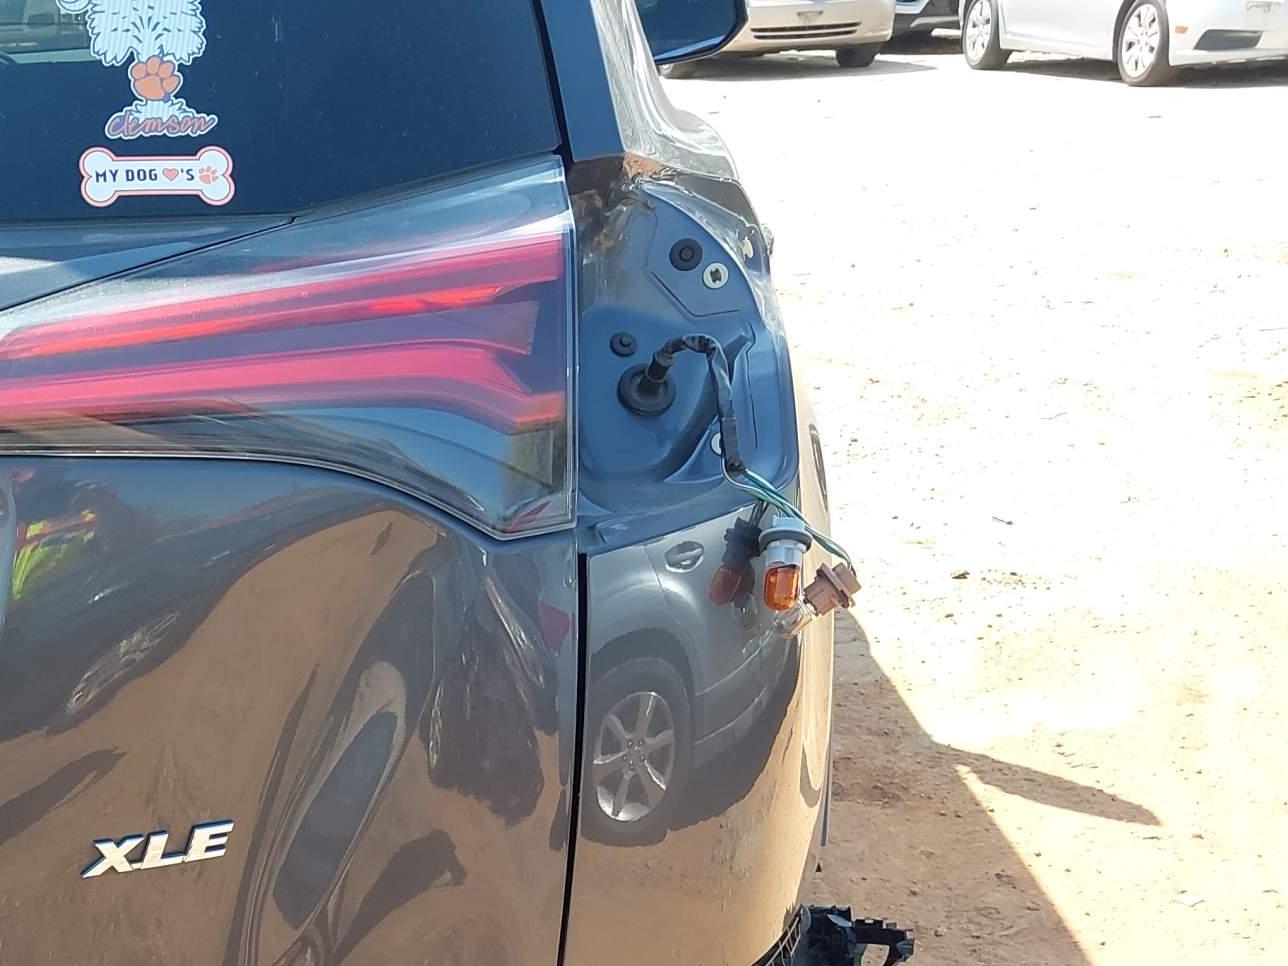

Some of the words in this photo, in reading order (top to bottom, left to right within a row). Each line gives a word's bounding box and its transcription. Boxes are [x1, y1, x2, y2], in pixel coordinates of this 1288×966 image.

[95, 169, 119, 183] MY
[126, 168, 158, 182] DOG
[80, 819, 235, 880] XLE
